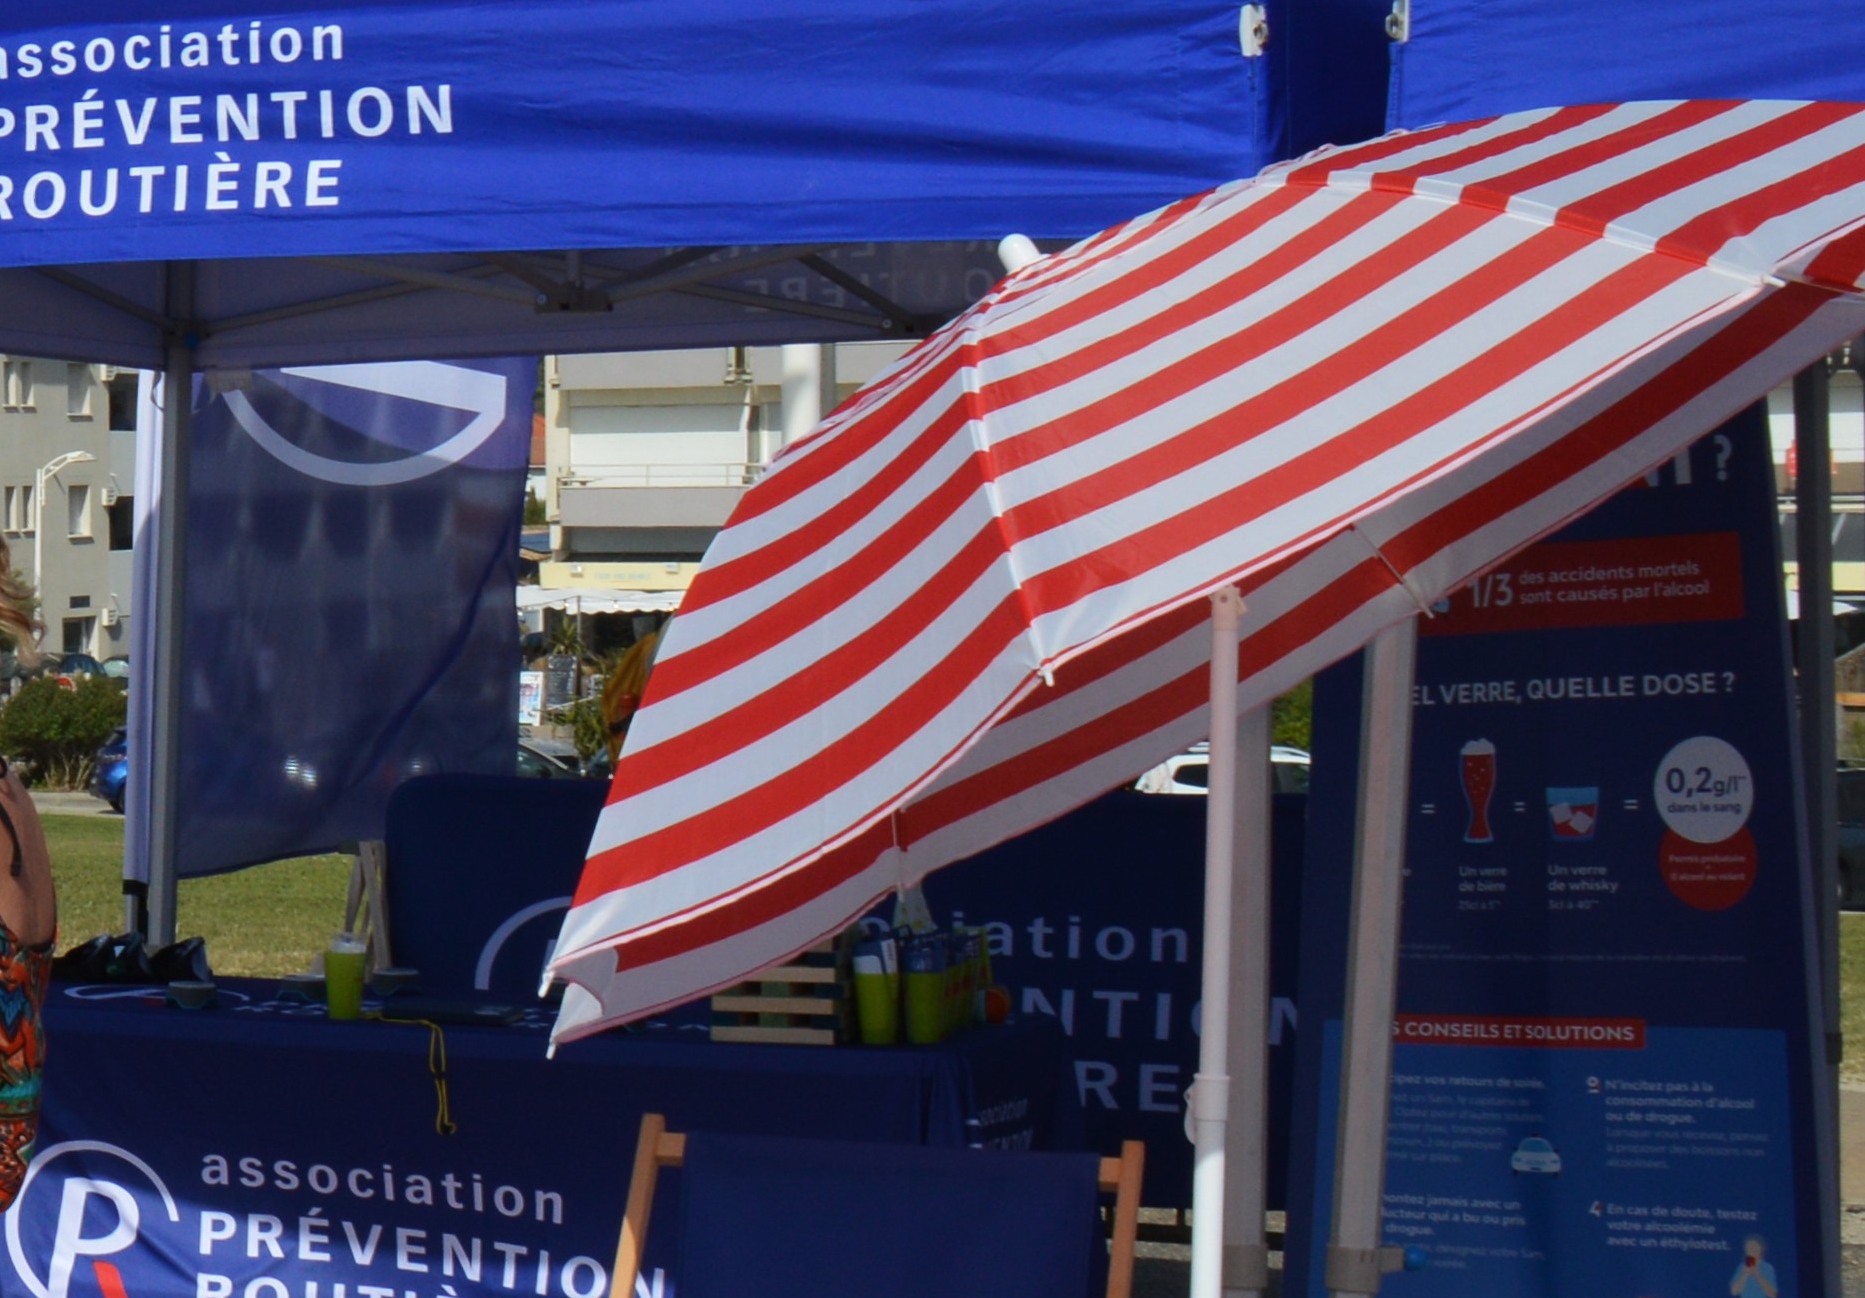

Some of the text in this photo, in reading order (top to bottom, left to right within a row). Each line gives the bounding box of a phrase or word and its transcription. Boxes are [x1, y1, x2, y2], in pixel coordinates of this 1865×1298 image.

[1468, 560, 1700, 608] 1/3 des accidents mortels
[1519, 580, 1711, 605] sont causés par l'alcool
[1439, 680, 1522, 705] VERRE,
[1527, 675, 1635, 700] QUELLE
[1642, 672, 1716, 697] DOSE
[1667, 800, 1742, 816] dans le sang
[1459, 865, 1507, 877] Un verre
[1548, 865, 1607, 877] Un verre
[1458, 880, 1507, 891] de bière
[1548, 879, 1618, 894] de whisky
[1404, 1022, 1499, 1039] CONSEILS
[1503, 1023, 1522, 1039] ET
[1524, 1023, 1635, 1042] SOLUTIONS
[1423, 1078, 1446, 1088] vos
[1448, 1075, 1493, 1088] retours
[1495, 1076, 1511, 1088] de
[1605, 1079, 1663, 1092] N'incitez
[1666, 1082, 1689, 1094] pas
[1702, 1081, 1714, 1092] la
[1605, 1096, 1756, 1110] consommation d'alcool
[1605, 1111, 1696, 1125] ou de drogue.
[201, 1152, 565, 1226] association
[1426, 1195, 1469, 1209] jamais
[1471, 1199, 1502, 1209] avec
[1504, 1199, 1521, 1210] un
[1428, 1210, 1450, 1223] qui
[1452, 1212, 1460, 1222] a
[1462, 1211, 1481, 1223] bu
[1483, 1214, 1500, 1224] ou
[1502, 1214, 1527, 1227] pris
[1607, 1203, 1758, 1221] En cas de doute, testez
[1386, 1222, 1435, 1237] drogue.
[1607, 1220, 1716, 1235] votre alcoolémie
[1607, 1235, 1732, 1252] avec un éthylotest.
